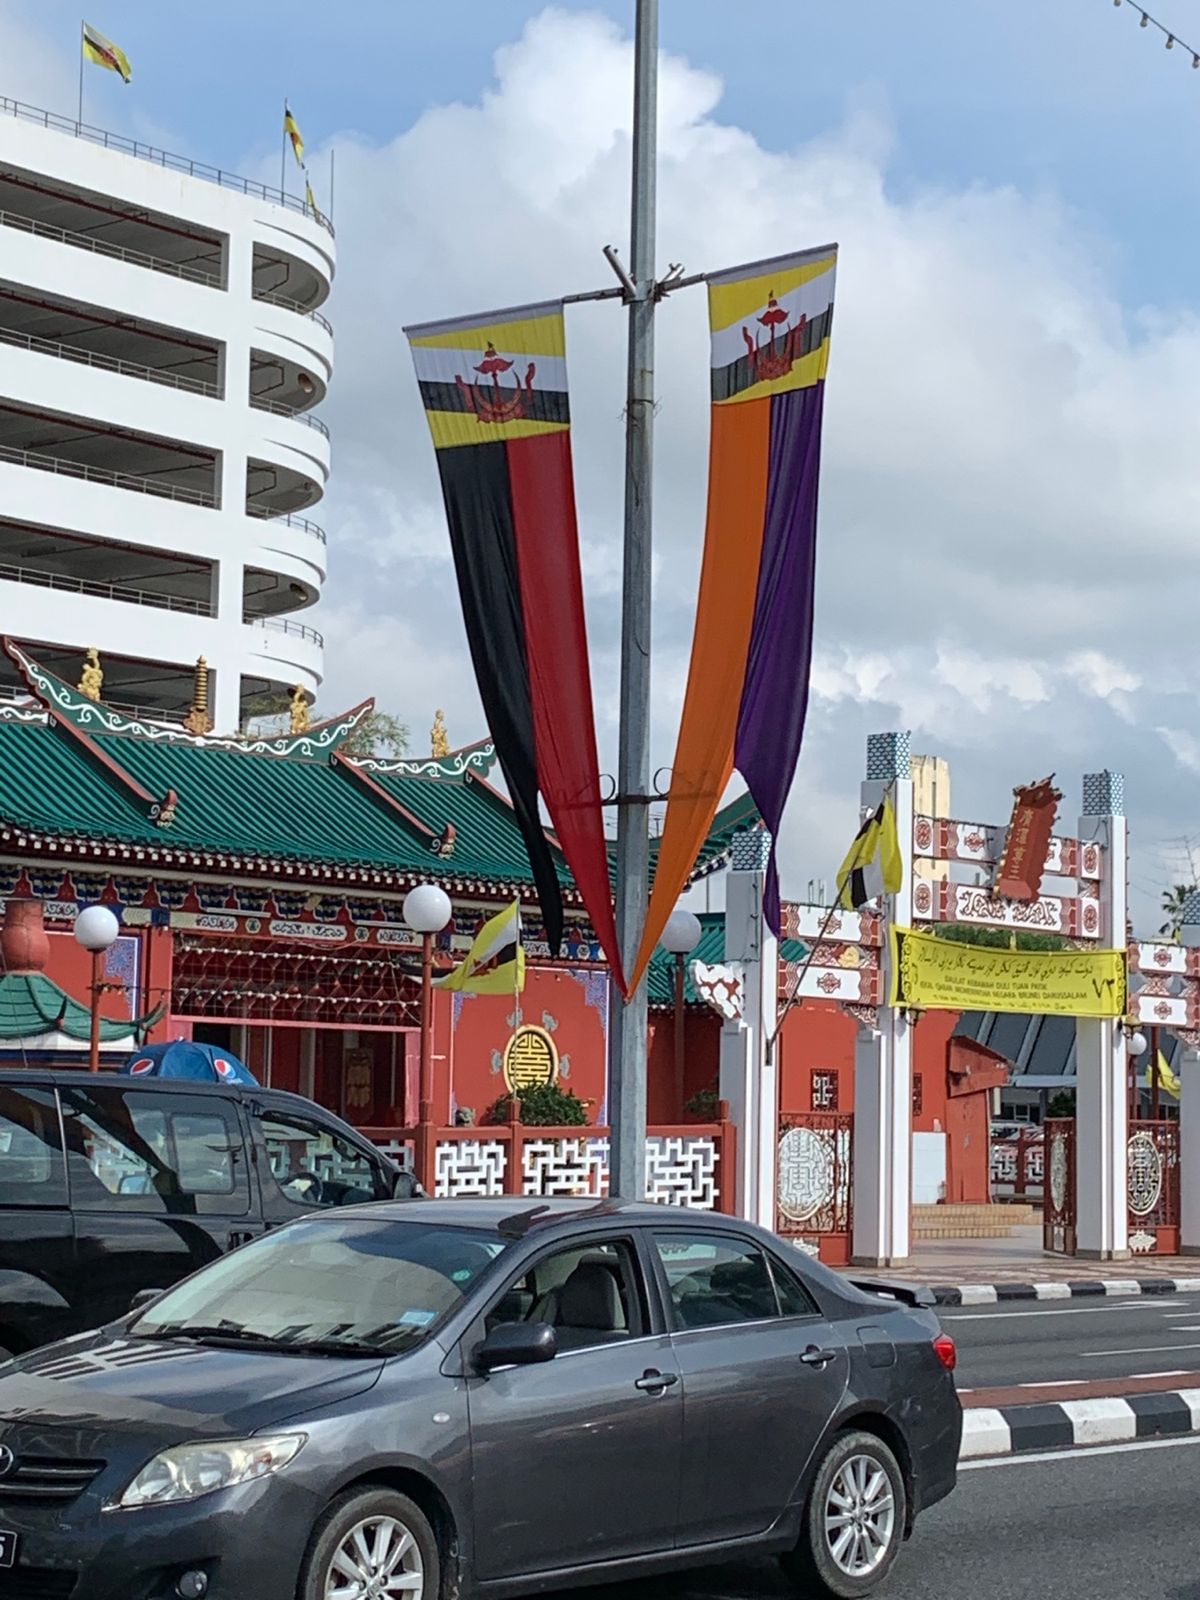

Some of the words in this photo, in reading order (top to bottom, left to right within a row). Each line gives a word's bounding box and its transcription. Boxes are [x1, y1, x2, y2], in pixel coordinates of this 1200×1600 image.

[944, 975, 966, 985] DAULAT
[1012, 982, 1029, 990] TUAN
[1018, 991, 1041, 999] BRUNEI
[1042, 991, 1088, 1000] DARUSSALAM
